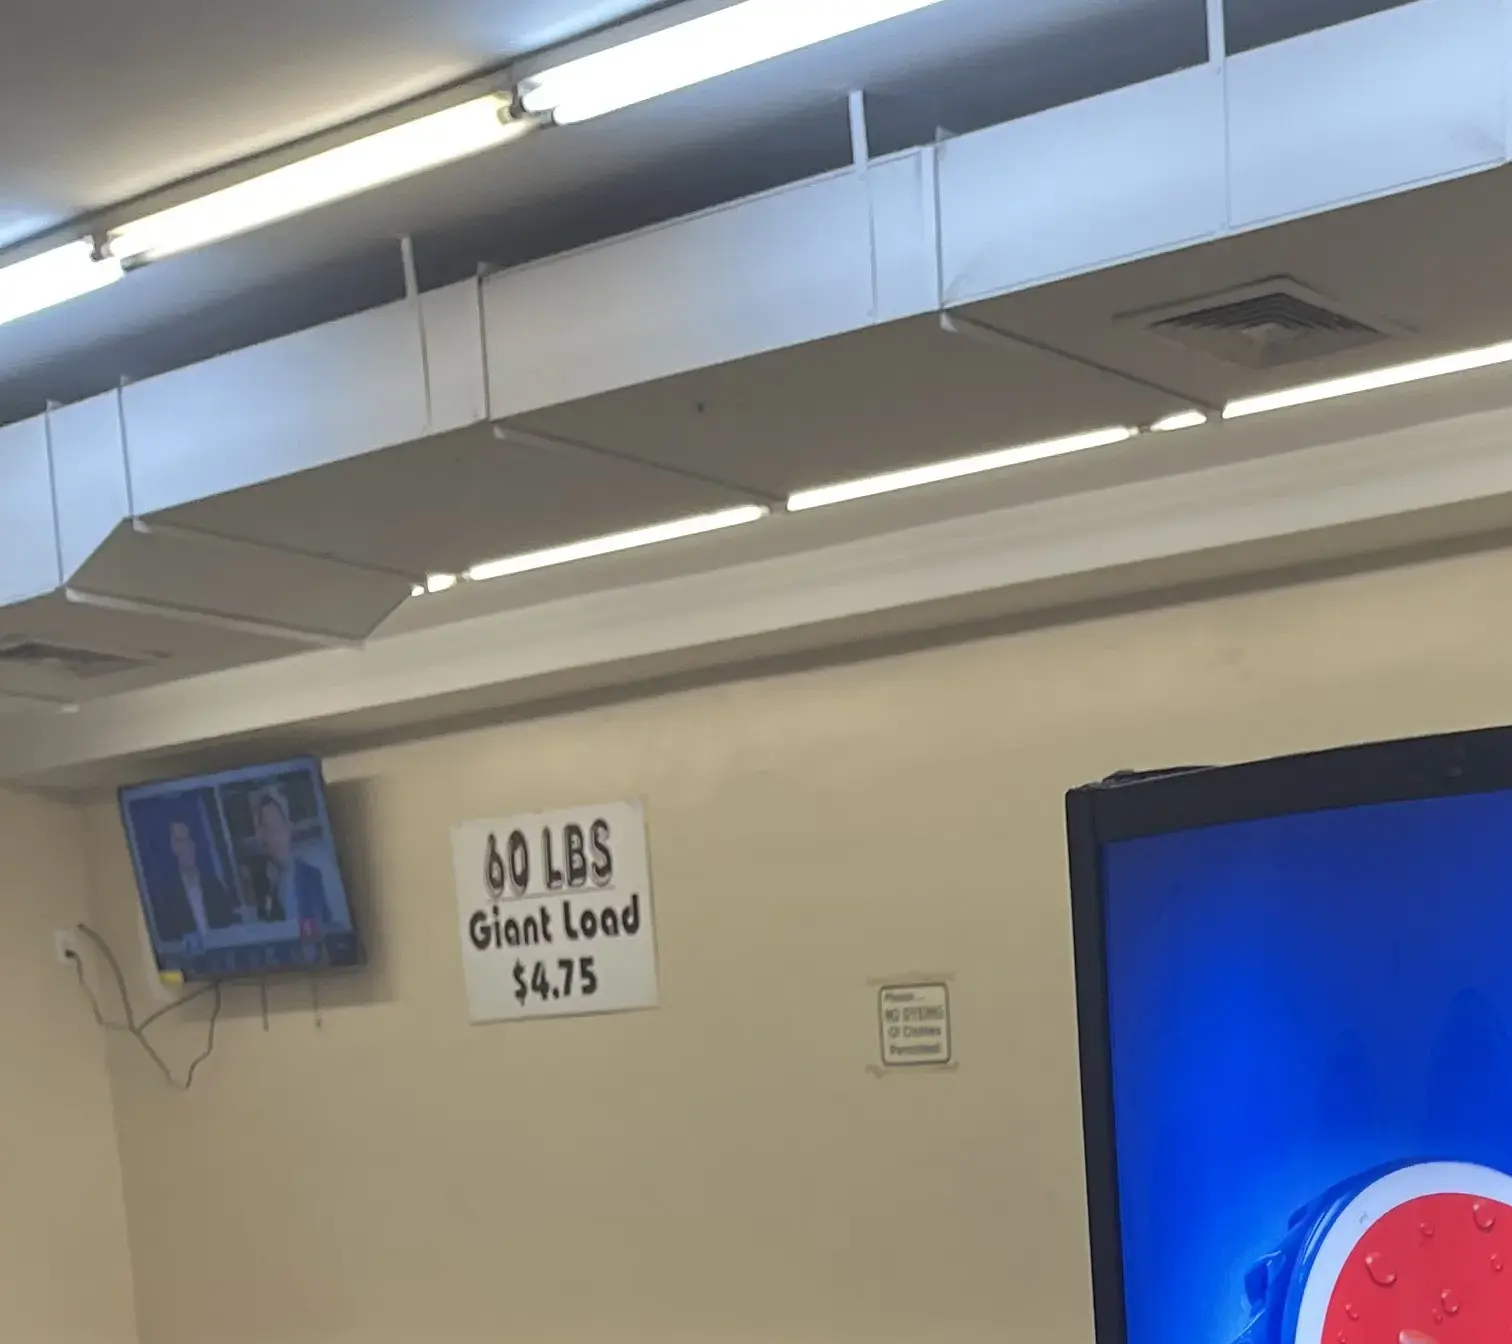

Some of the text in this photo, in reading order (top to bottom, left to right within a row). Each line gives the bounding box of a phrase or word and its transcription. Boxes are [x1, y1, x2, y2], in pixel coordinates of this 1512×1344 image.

[484, 817, 614, 899] 60 LBS
[469, 893, 641, 951] Giant Load
[512, 956, 598, 1006] $4.75
